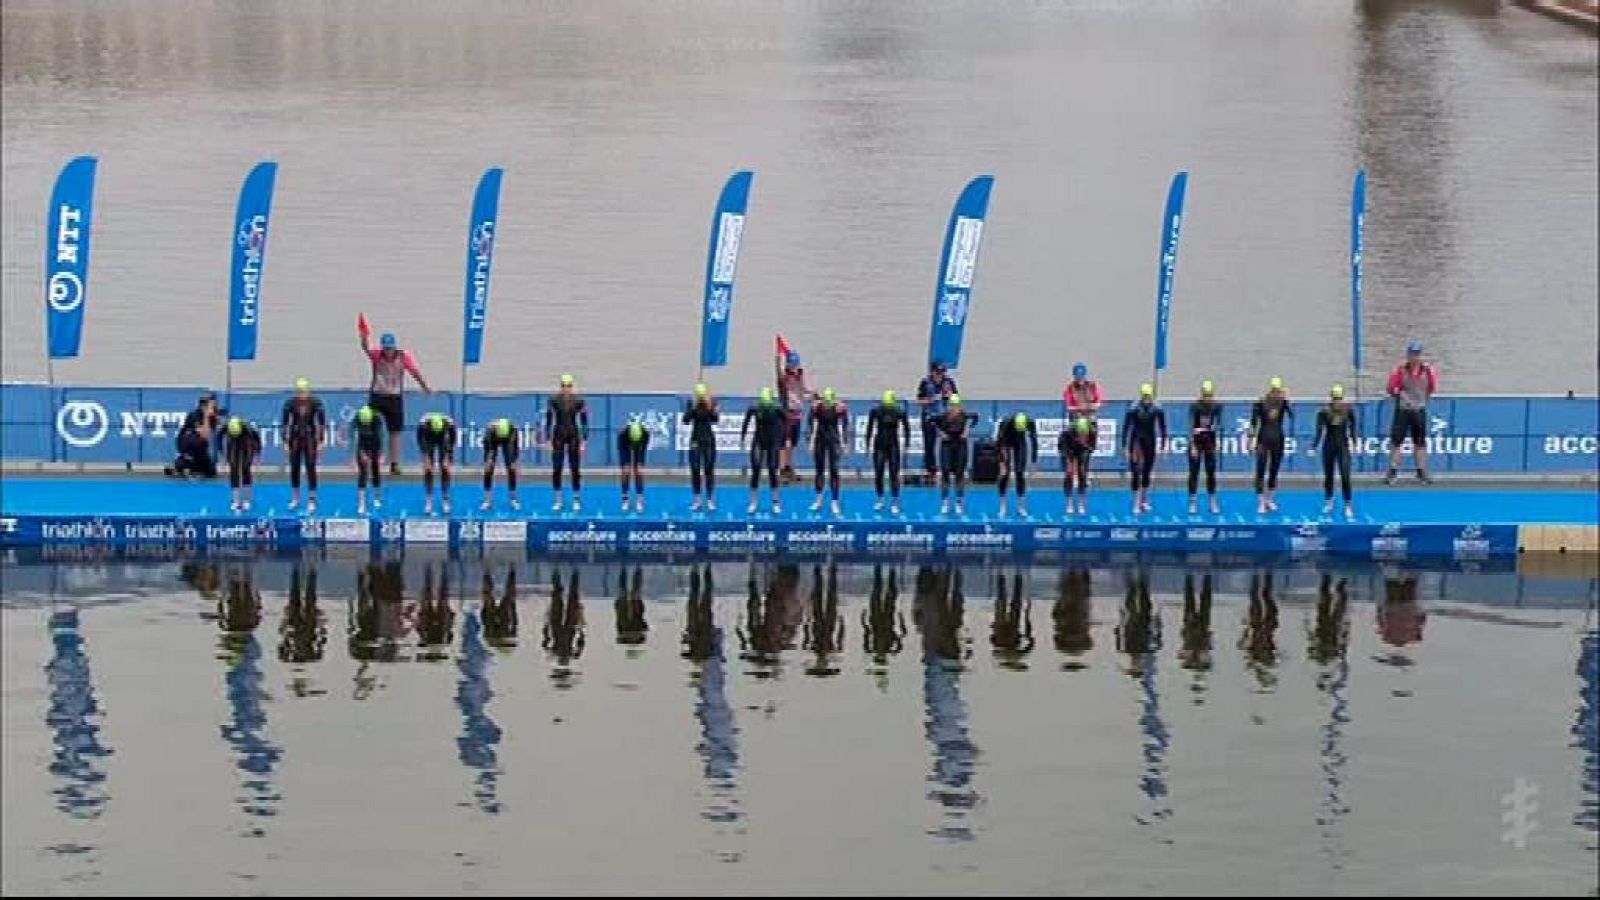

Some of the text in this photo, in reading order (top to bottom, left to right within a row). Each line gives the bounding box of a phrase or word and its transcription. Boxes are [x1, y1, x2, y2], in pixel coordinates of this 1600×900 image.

[57, 203, 80, 263] NTT
[120, 411, 188, 436] NTT
[42, 521, 116, 539] triathlon
[125, 522, 197, 539] triathlon
[205, 522, 278, 539] triathlon
[547, 527, 617, 542] accenture
[628, 527, 697, 542] accenture
[708, 527, 776, 542] accenture
[787, 528, 855, 543] accenture
[866, 528, 935, 543] accenture
[945, 529, 1014, 544] accenture
